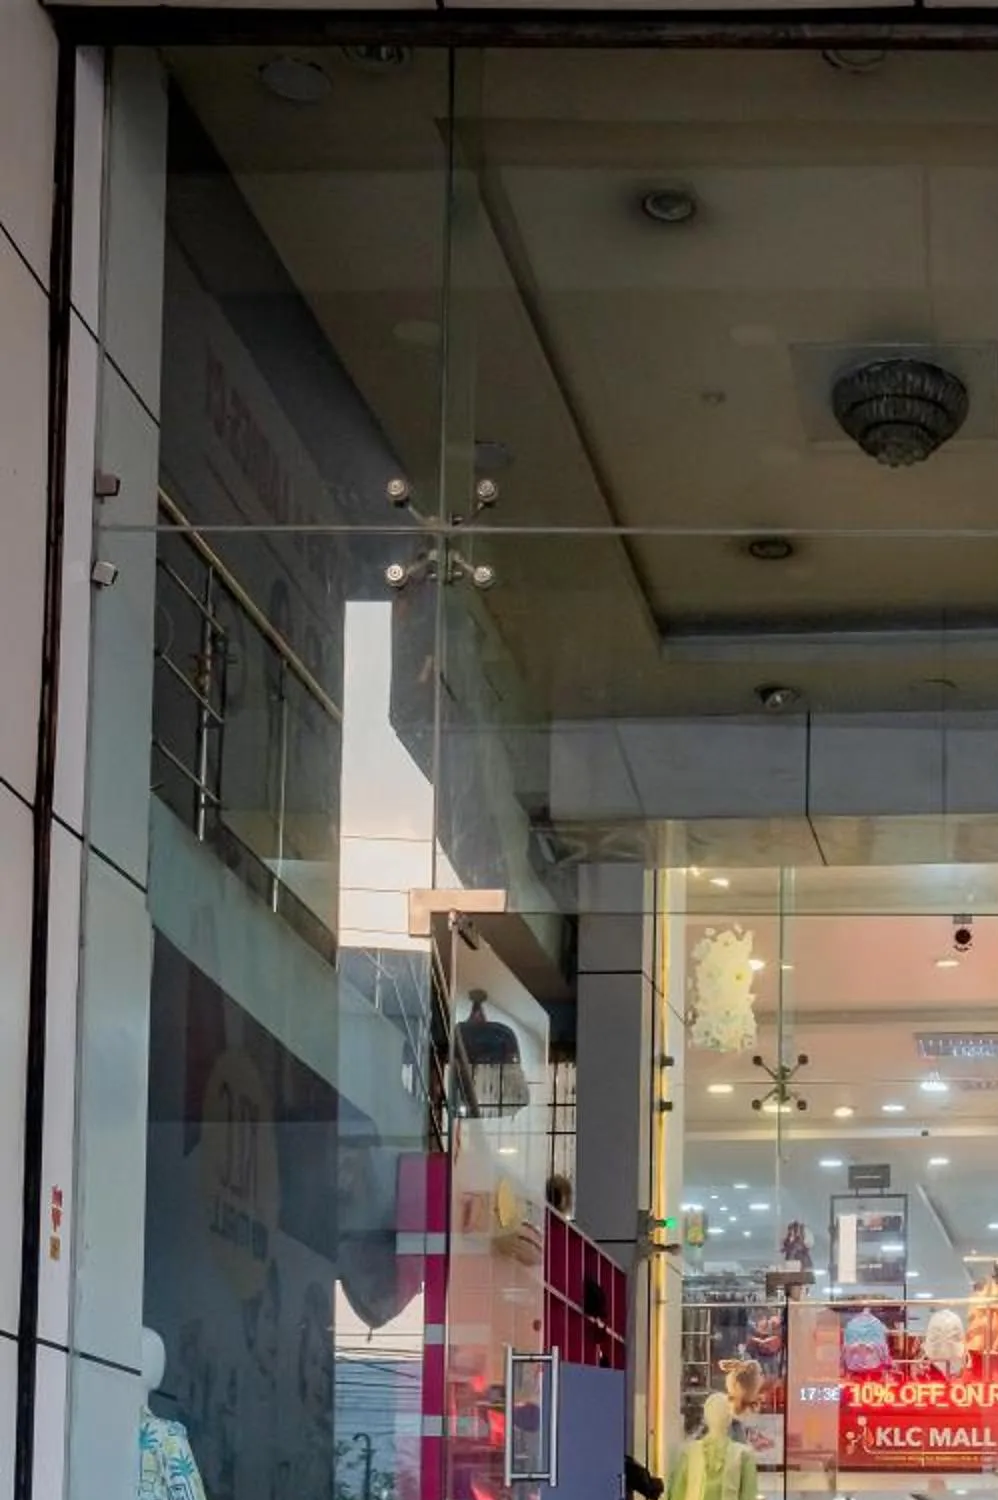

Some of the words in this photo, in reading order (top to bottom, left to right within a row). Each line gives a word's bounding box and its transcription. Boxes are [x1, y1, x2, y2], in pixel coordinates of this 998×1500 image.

[849, 1382, 895, 1405] 10%
[900, 1382, 945, 1405] OFF
[950, 1382, 985, 1406] ON
[876, 1428, 922, 1447] KLC
[929, 1428, 996, 1447] MALL
